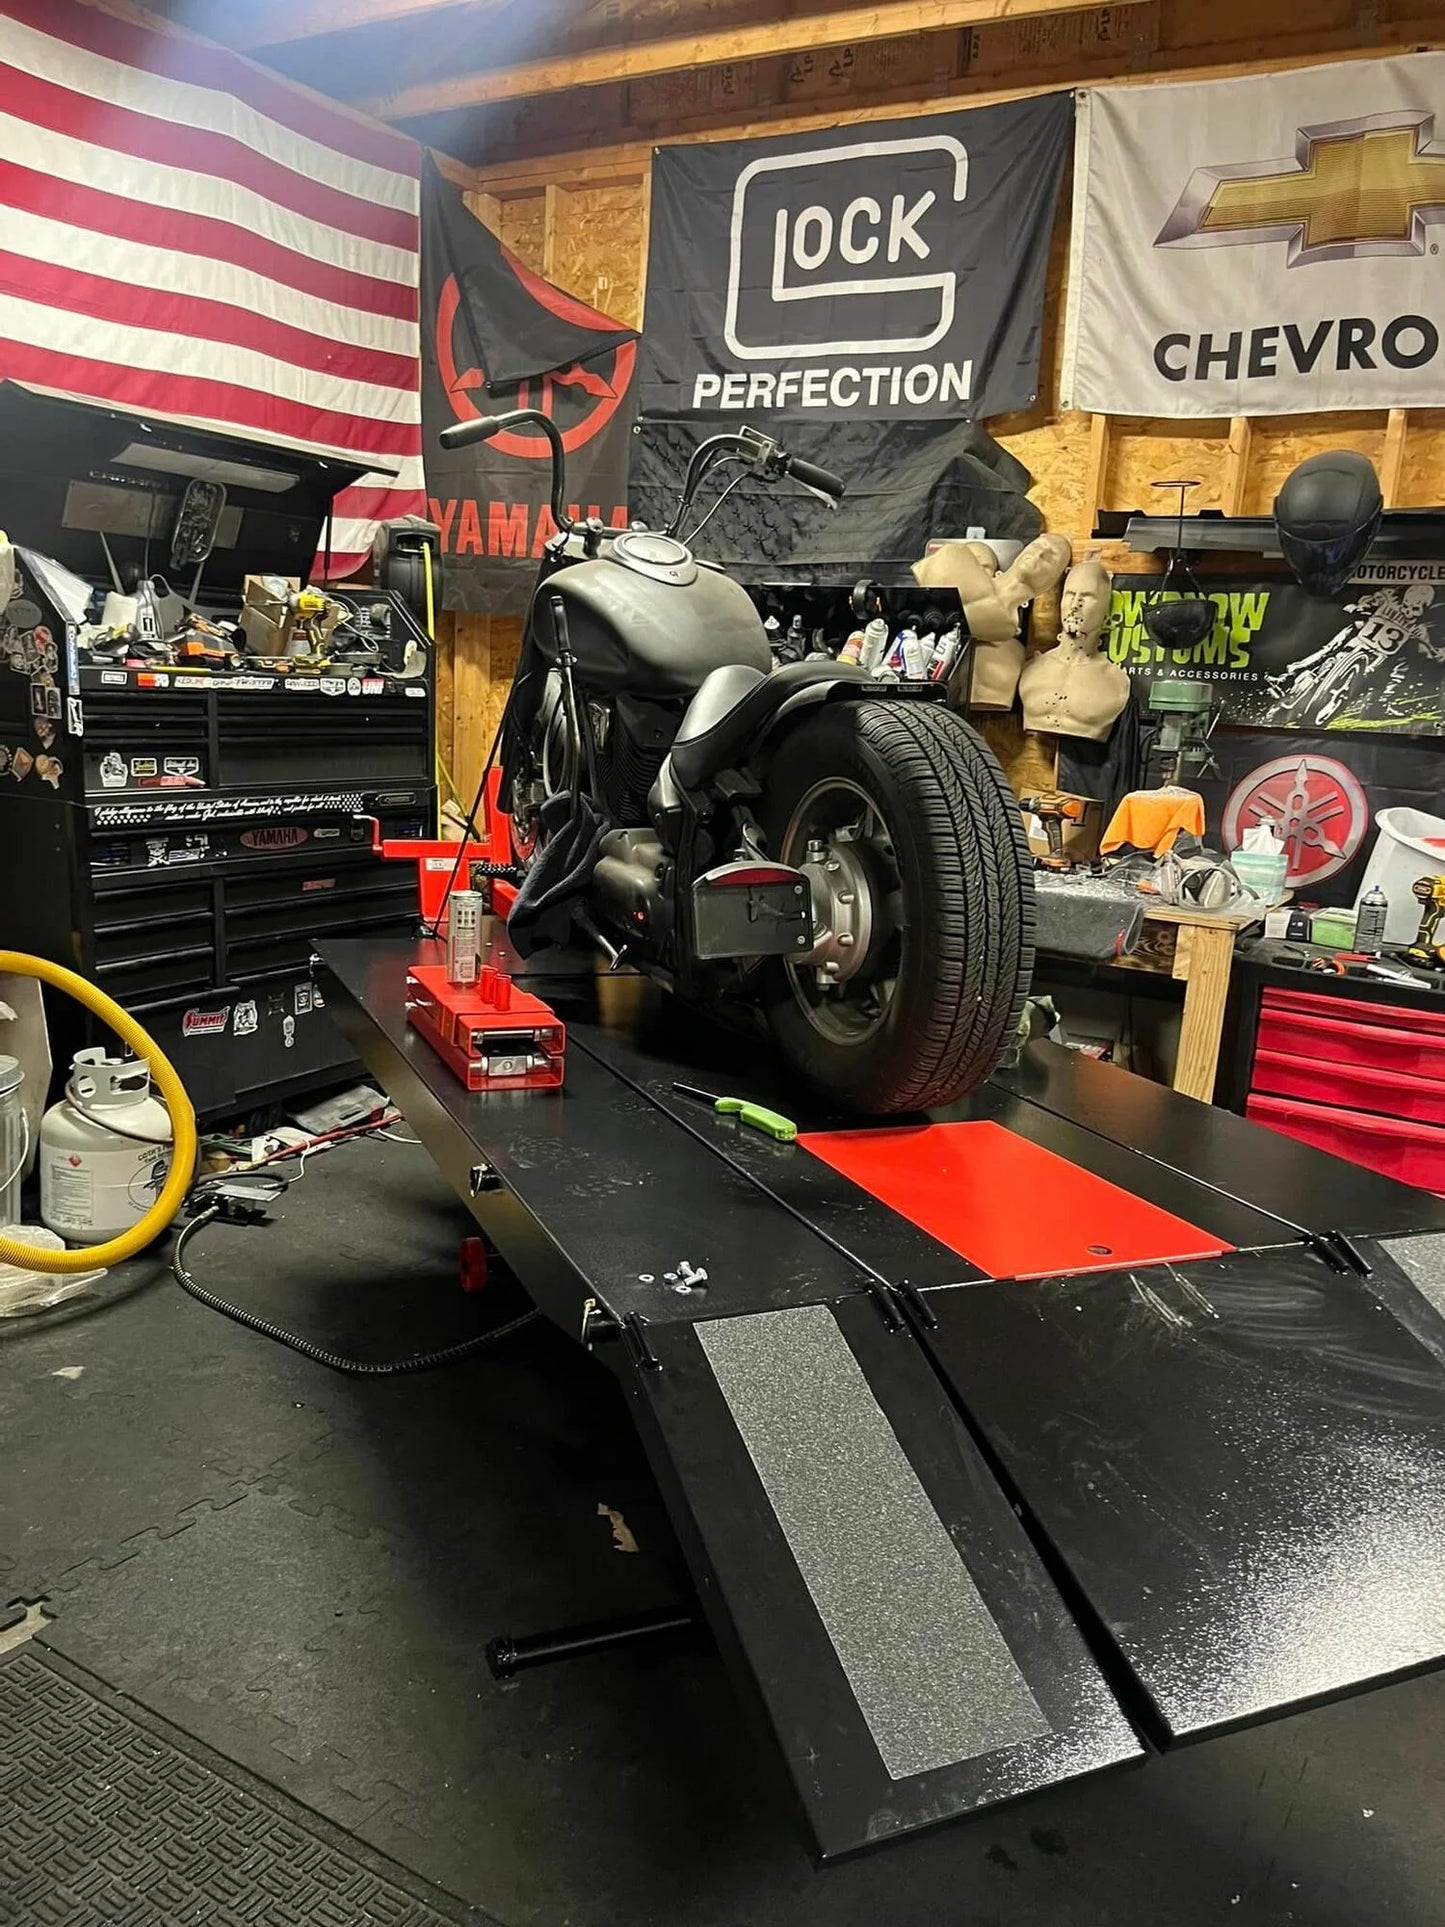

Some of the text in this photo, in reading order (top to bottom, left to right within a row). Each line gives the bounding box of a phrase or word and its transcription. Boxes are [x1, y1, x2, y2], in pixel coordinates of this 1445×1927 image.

[692, 360, 973, 409] PERFECTION
[428, 498, 628, 559] YAMA
[1351, 564, 1445, 580] OTORCYCLE
[1362, 621, 1404, 652] 13
[1170, 669, 1258, 681] ACCESSORIES
[252, 829, 298, 846] YAMAHA
